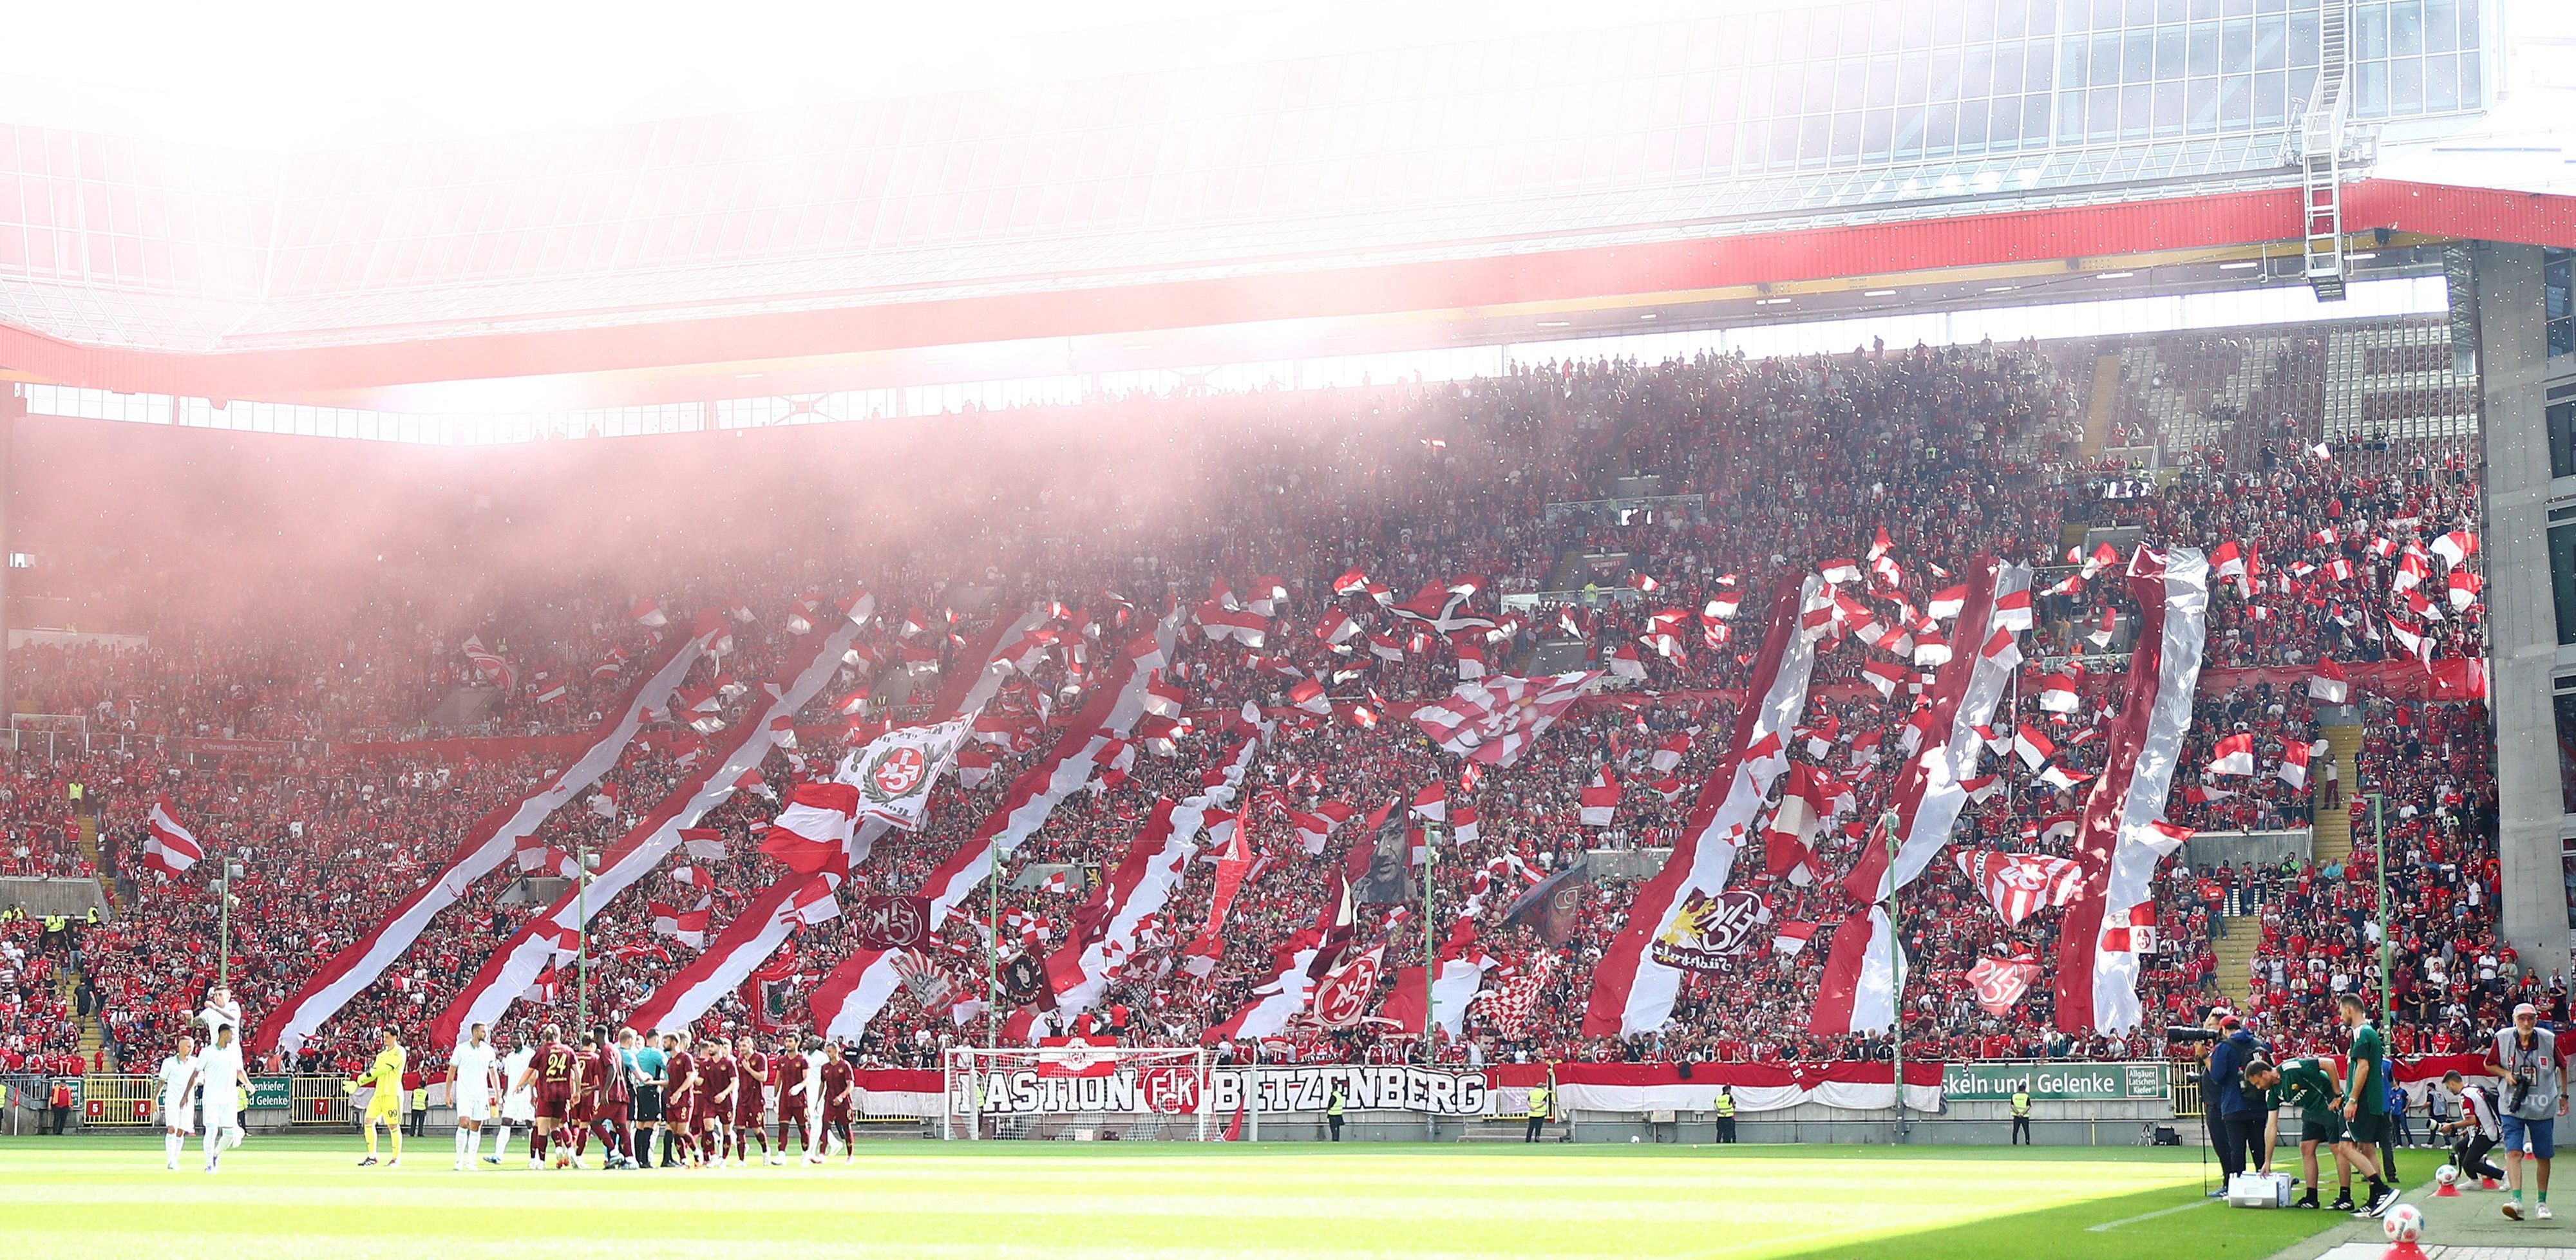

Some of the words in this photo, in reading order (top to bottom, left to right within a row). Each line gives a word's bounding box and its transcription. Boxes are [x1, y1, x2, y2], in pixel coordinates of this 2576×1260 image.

[546, 1053, 567, 1076] 24
[2129, 1069, 2155, 1079] Allgäuer
[2037, 1073, 2115, 1094] Gelenke
[256, 1096, 288, 1105] Gelenke
[92, 1104, 99, 1113] 5
[138, 1104, 146, 1113] 6
[318, 1102, 325, 1111] 7
